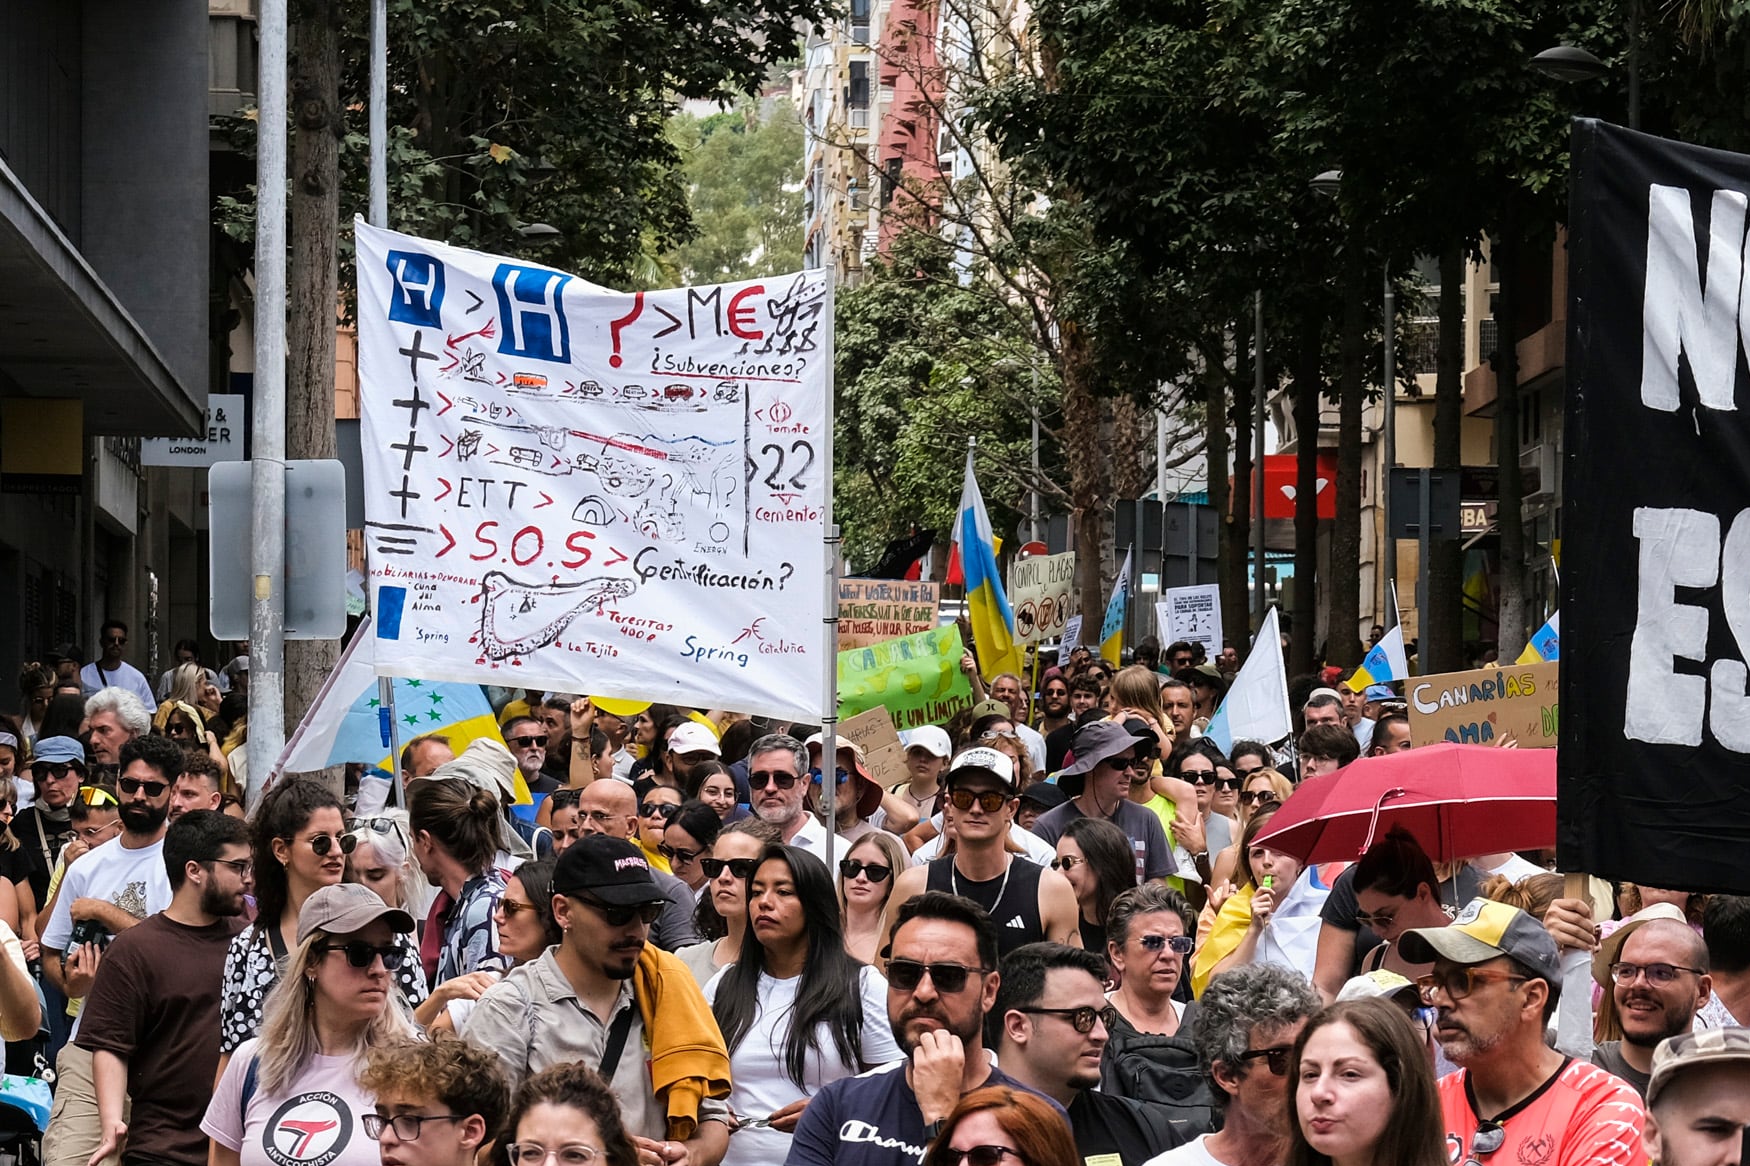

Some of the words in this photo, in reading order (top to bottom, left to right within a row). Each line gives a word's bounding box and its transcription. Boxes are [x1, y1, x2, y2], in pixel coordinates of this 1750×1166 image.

[651, 347, 807, 379] ¿Subvenciones?
[169, 446, 207, 455] LONDON
[1461, 509, 1488, 526] BA
[411, 601, 441, 612] Alma
[415, 627, 449, 644] Spring
[680, 635, 749, 667] Spring
[1413, 671, 1536, 714] CANARiAS
[1444, 720, 1494, 744] AMA
[299, 1092, 339, 1105] ACCIÓN
